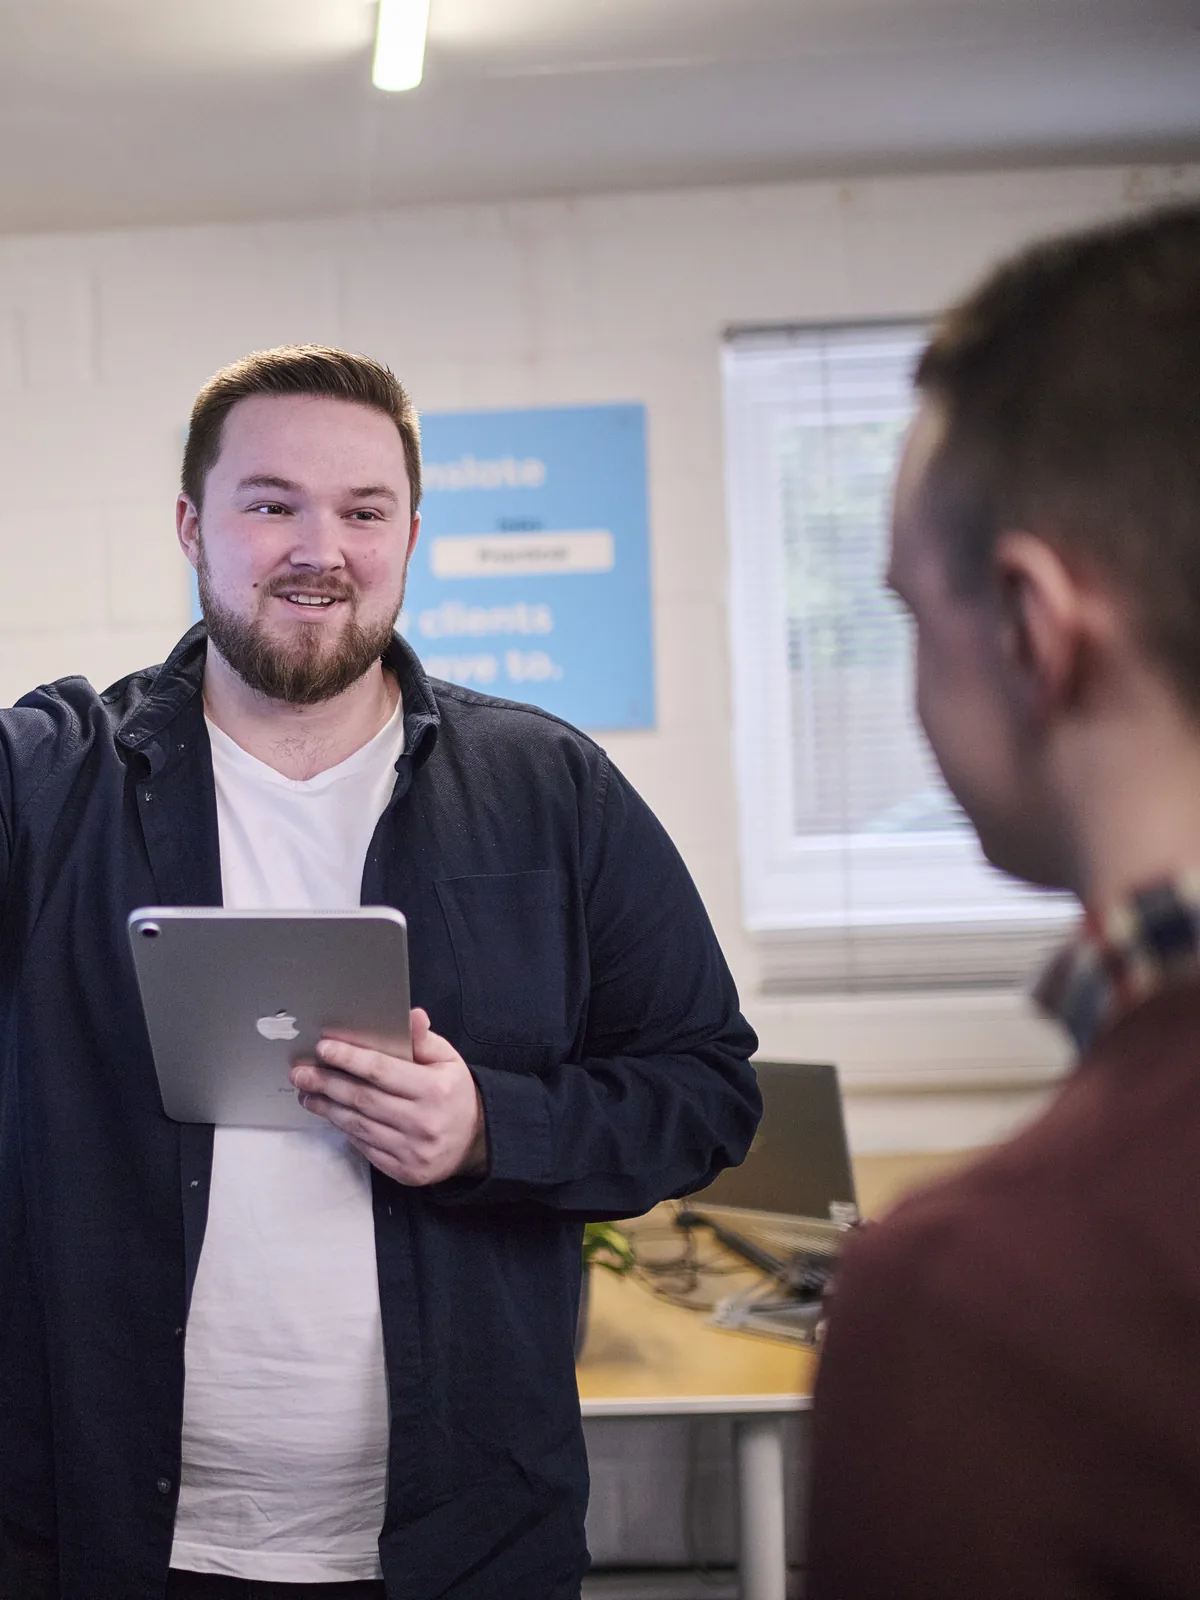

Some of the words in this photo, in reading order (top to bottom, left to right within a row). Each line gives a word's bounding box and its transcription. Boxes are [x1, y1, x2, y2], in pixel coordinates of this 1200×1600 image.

[421, 455, 546, 489] nslate
[419, 601, 553, 637] clients
[422, 654, 497, 684] ave
[506, 650, 563, 683] to.
